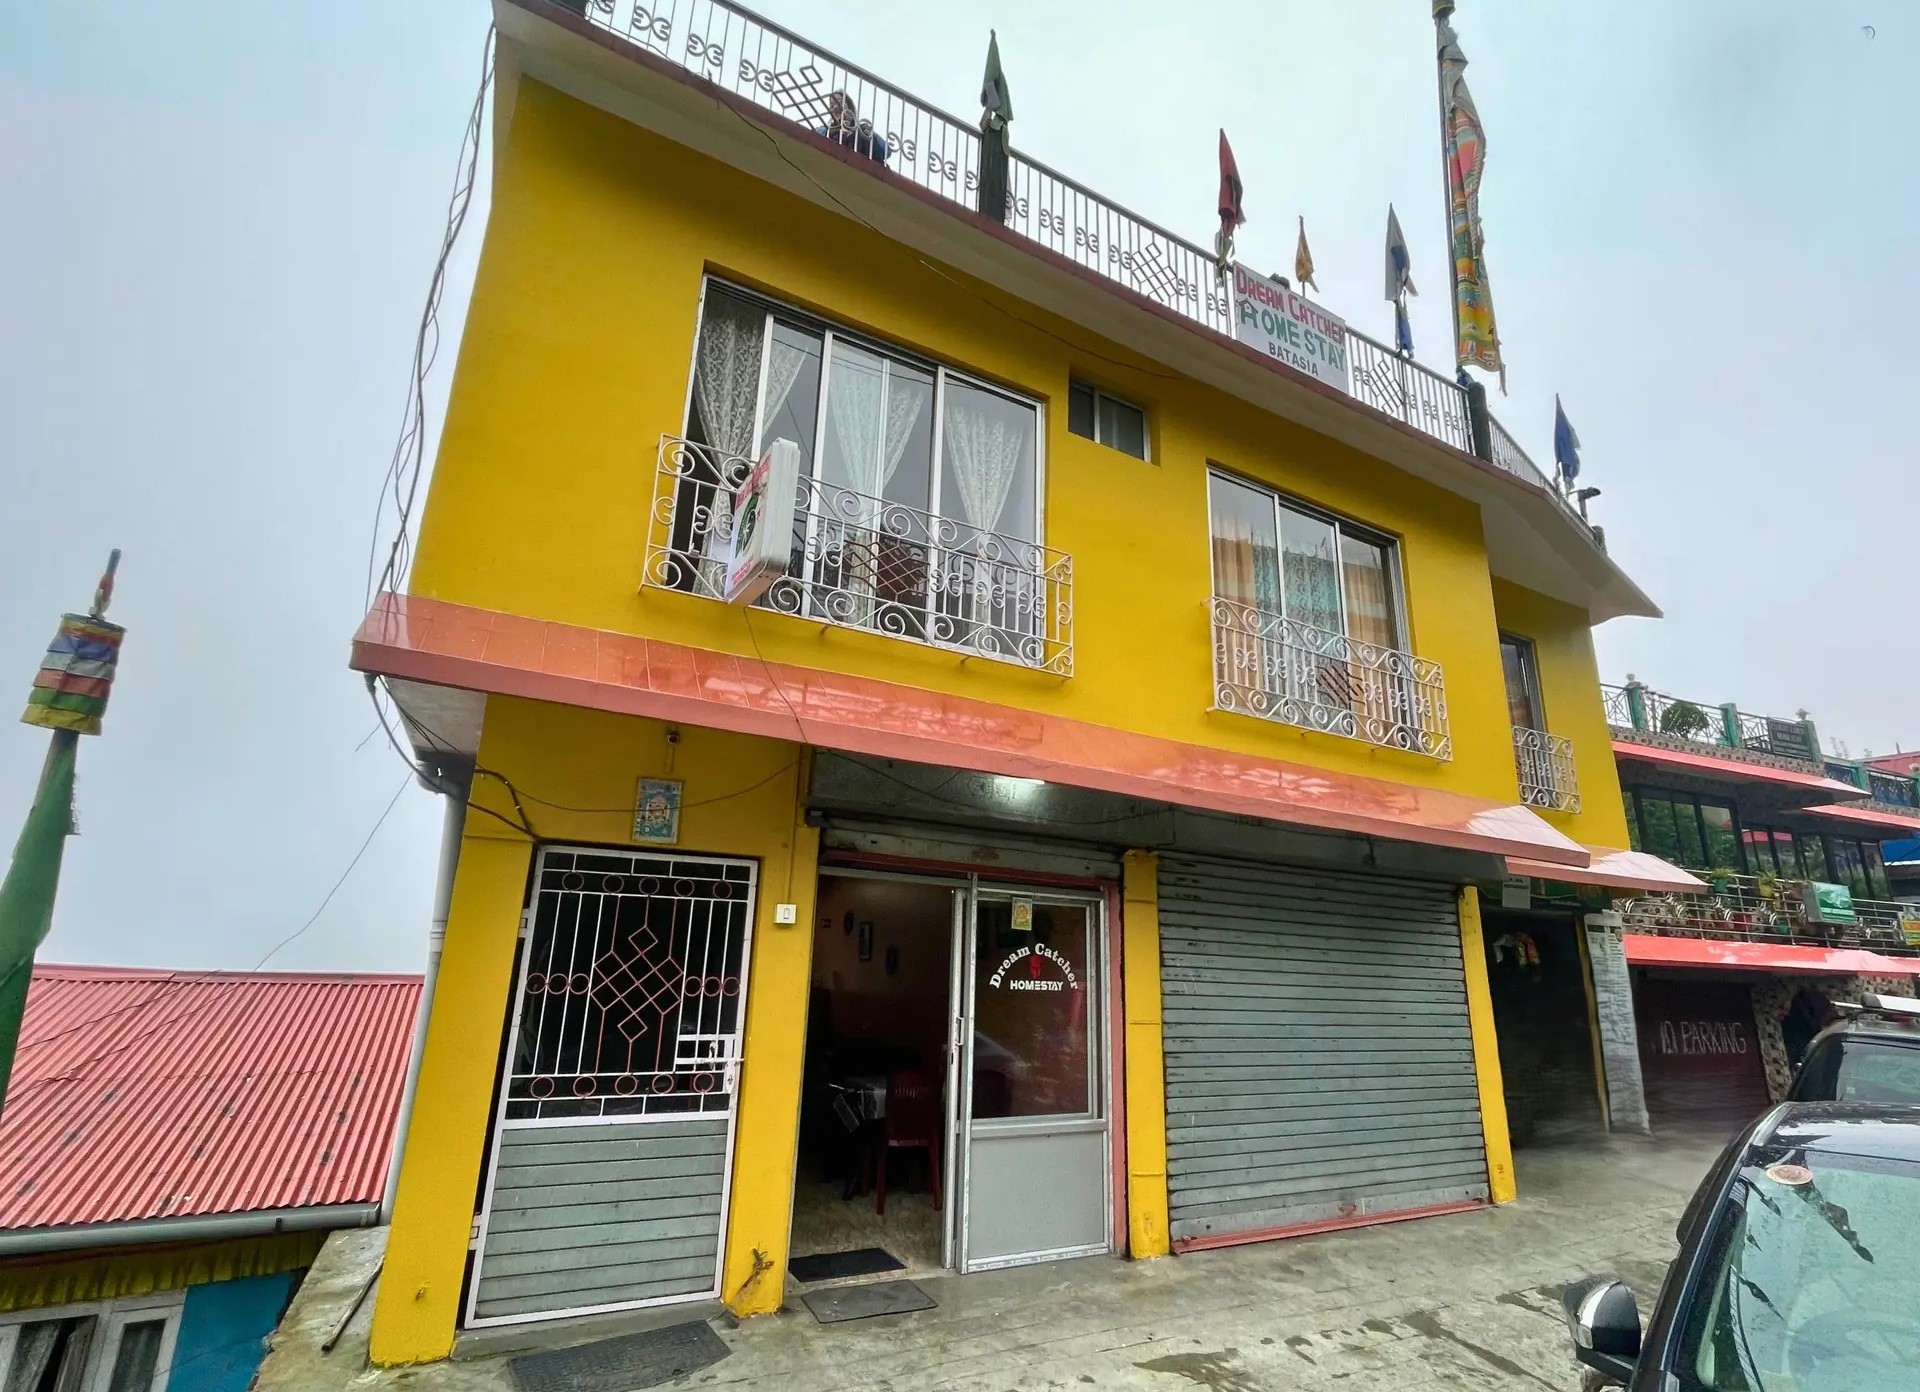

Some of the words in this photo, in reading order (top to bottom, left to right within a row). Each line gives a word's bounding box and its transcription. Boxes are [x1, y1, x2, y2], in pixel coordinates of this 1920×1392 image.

[1236, 266, 1285, 312] DREAM
[1288, 294, 1345, 346] CATCHER
[1268, 341, 1319, 377] BATASIA
[989, 946, 1031, 988] Dream
[1035, 943, 1078, 990] Catcher
[1010, 980, 1063, 991] HOMESTAY
[1681, 1020, 1747, 1054] PARKING
